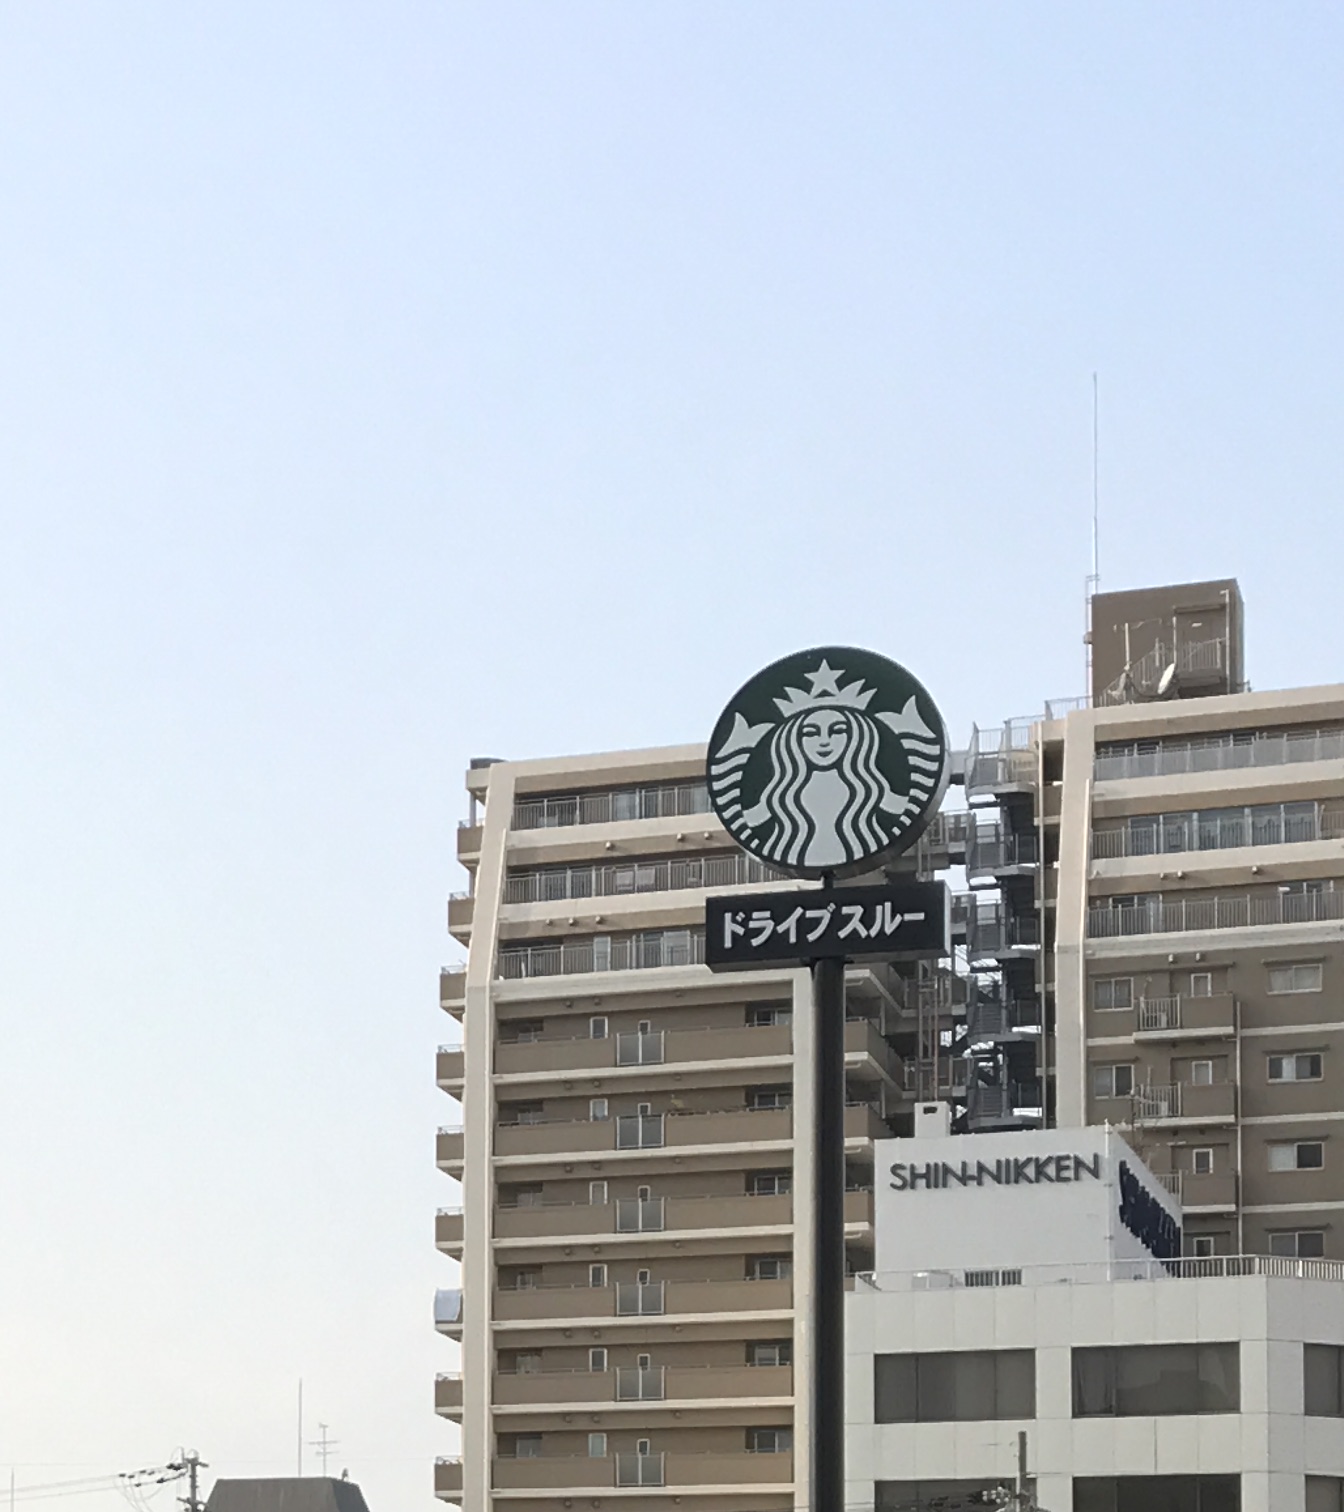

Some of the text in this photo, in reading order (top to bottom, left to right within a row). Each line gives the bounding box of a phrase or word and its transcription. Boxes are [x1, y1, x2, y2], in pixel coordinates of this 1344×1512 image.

[723, 901, 926, 949] ドライブスルー
[889, 1152, 1101, 1191] SHIN-NIKKEN
